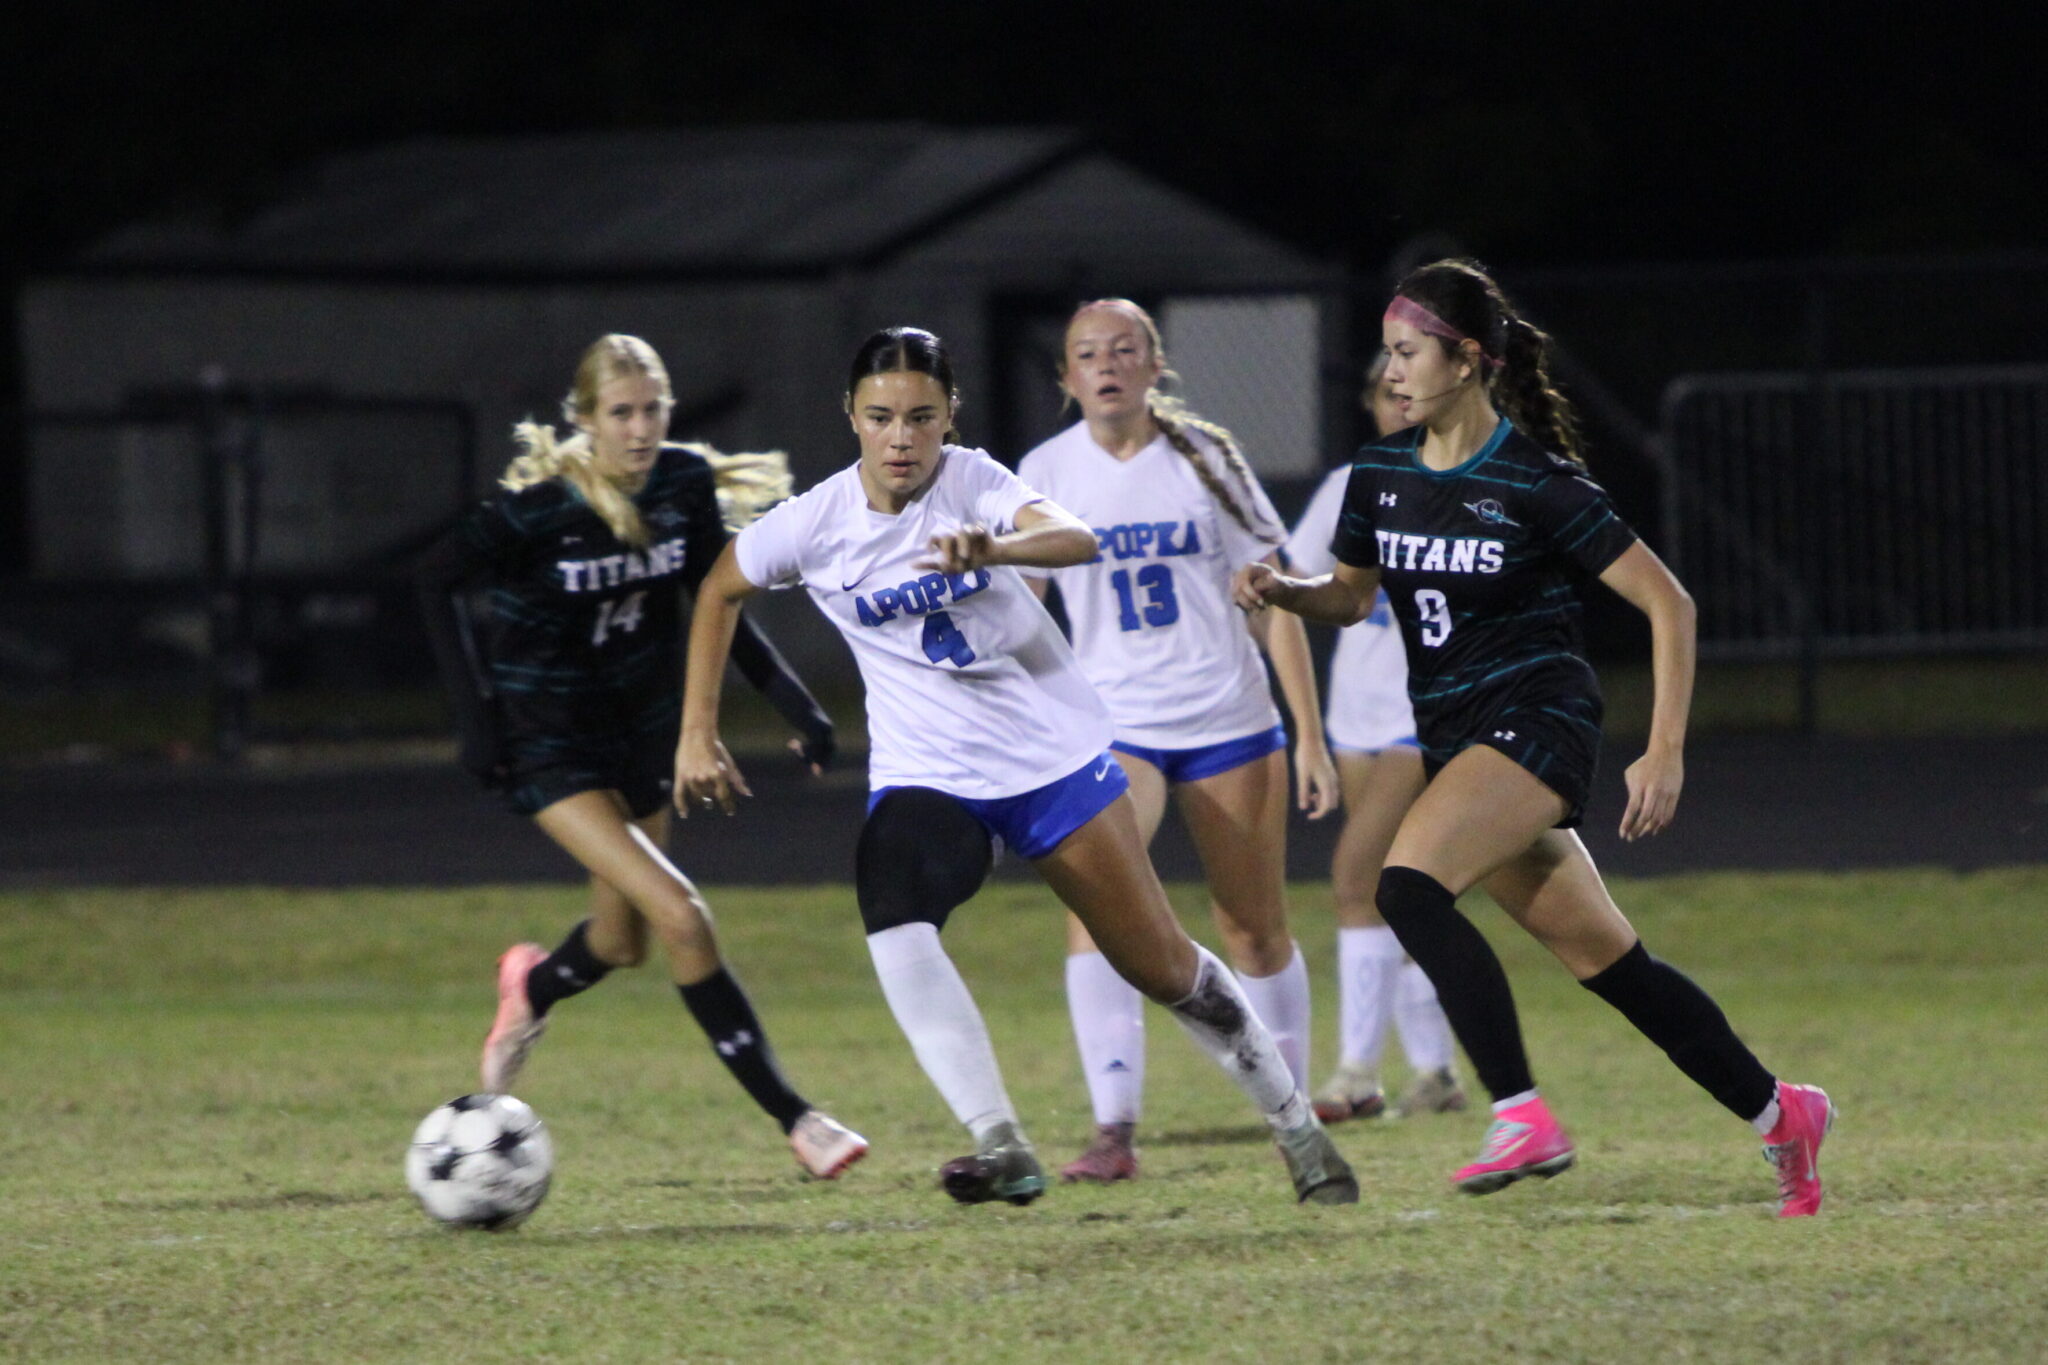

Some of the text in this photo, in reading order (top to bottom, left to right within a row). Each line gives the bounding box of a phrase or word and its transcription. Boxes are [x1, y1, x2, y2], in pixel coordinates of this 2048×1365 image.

[1084, 519, 1202, 563] POPKA
[1375, 529, 1505, 574] TITANS
[592, 590, 648, 647] 14
[1111, 563, 1180, 632] 13
[1414, 588, 1453, 648] 9
[922, 610, 976, 669] 4
